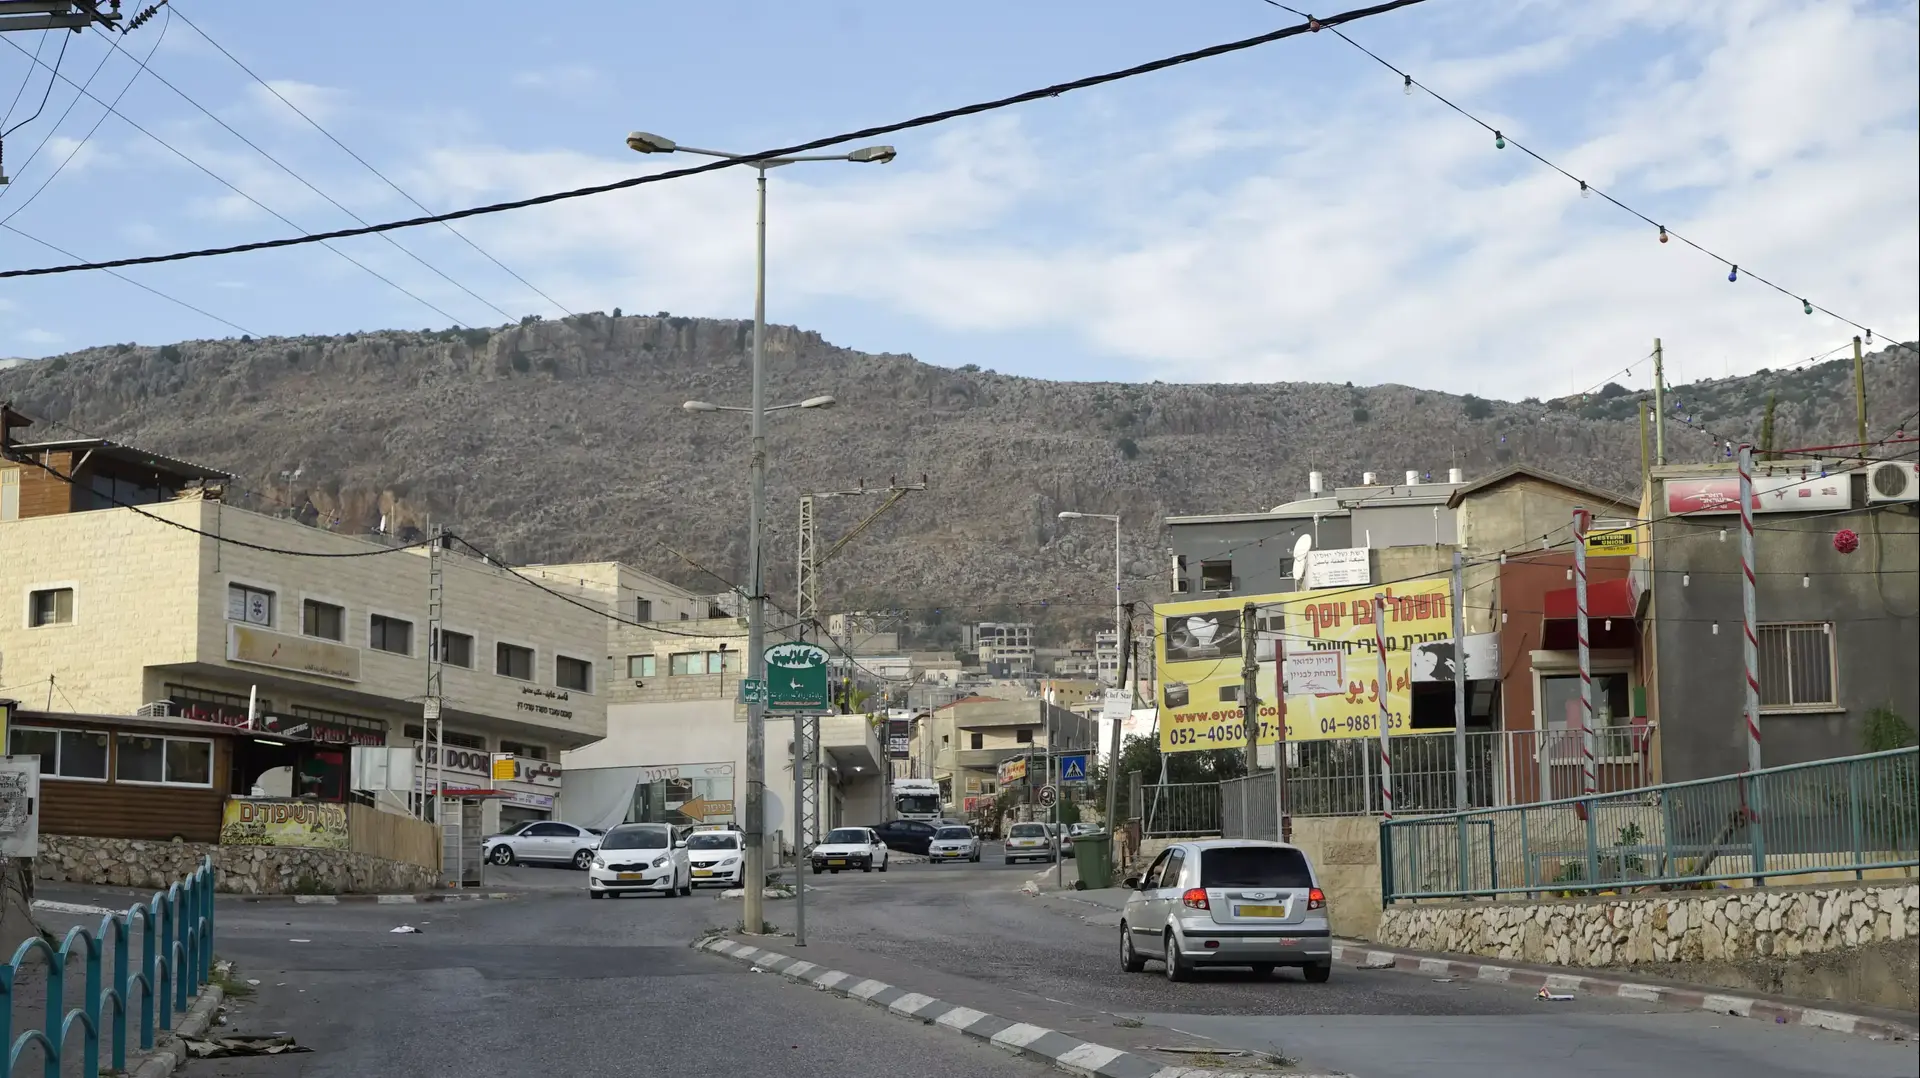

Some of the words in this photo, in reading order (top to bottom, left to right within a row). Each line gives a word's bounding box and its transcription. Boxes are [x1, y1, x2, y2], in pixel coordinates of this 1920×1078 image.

[1385, 587, 1446, 622] חשמל
[1305, 601, 1346, 638] יוסף
[1292, 656, 1314, 665] לדואר
[1316, 657, 1334, 666] חניון
[1314, 669, 1337, 678] מתחת
[1170, 722, 1268, 745] 052-40507
[1321, 712, 1402, 734] 04-988133
[240, 803, 318, 825] השיפודים
[320, 806, 343, 831] מלך
[703, 803, 732, 812] כניסה
